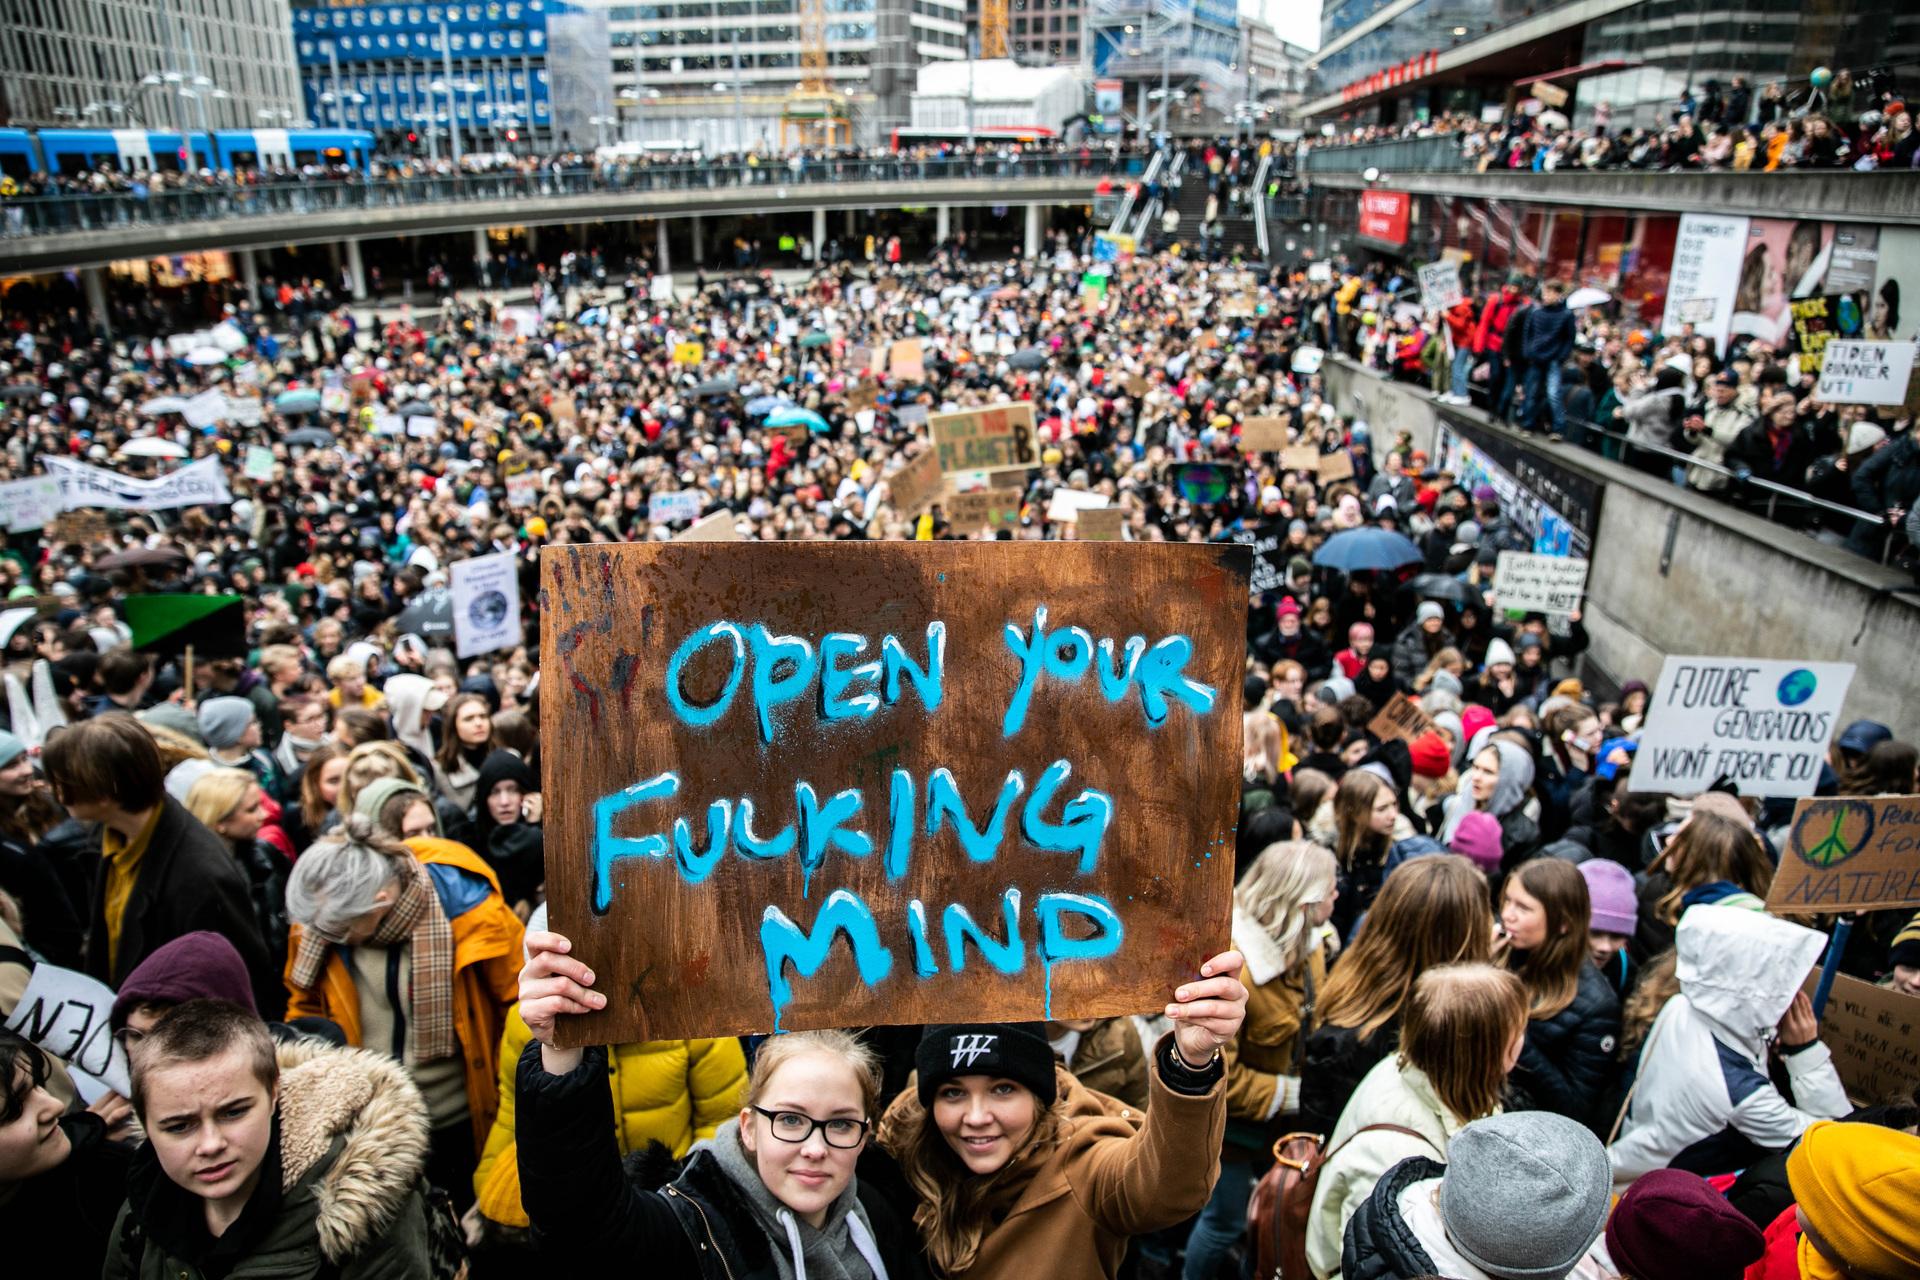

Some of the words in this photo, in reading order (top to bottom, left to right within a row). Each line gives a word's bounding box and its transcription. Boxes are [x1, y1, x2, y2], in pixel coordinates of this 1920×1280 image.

[1825, 362, 1890, 380] RINNER
[1832, 344, 1886, 364] TIDEN
[1820, 381, 1854, 396] UT!
[664, 618, 946, 746] OPEN
[1002, 604, 1217, 739] YOUR
[1667, 665, 1760, 708] FUTURE
[1713, 708, 1830, 744] GENERATIONS
[1713, 748, 1782, 784] FORGIVE
[1784, 753, 1819, 782] YOU
[590, 758, 1113, 917] FUCKING
[1877, 829, 1920, 853] Fo
[760, 887, 1124, 1014] MIND
